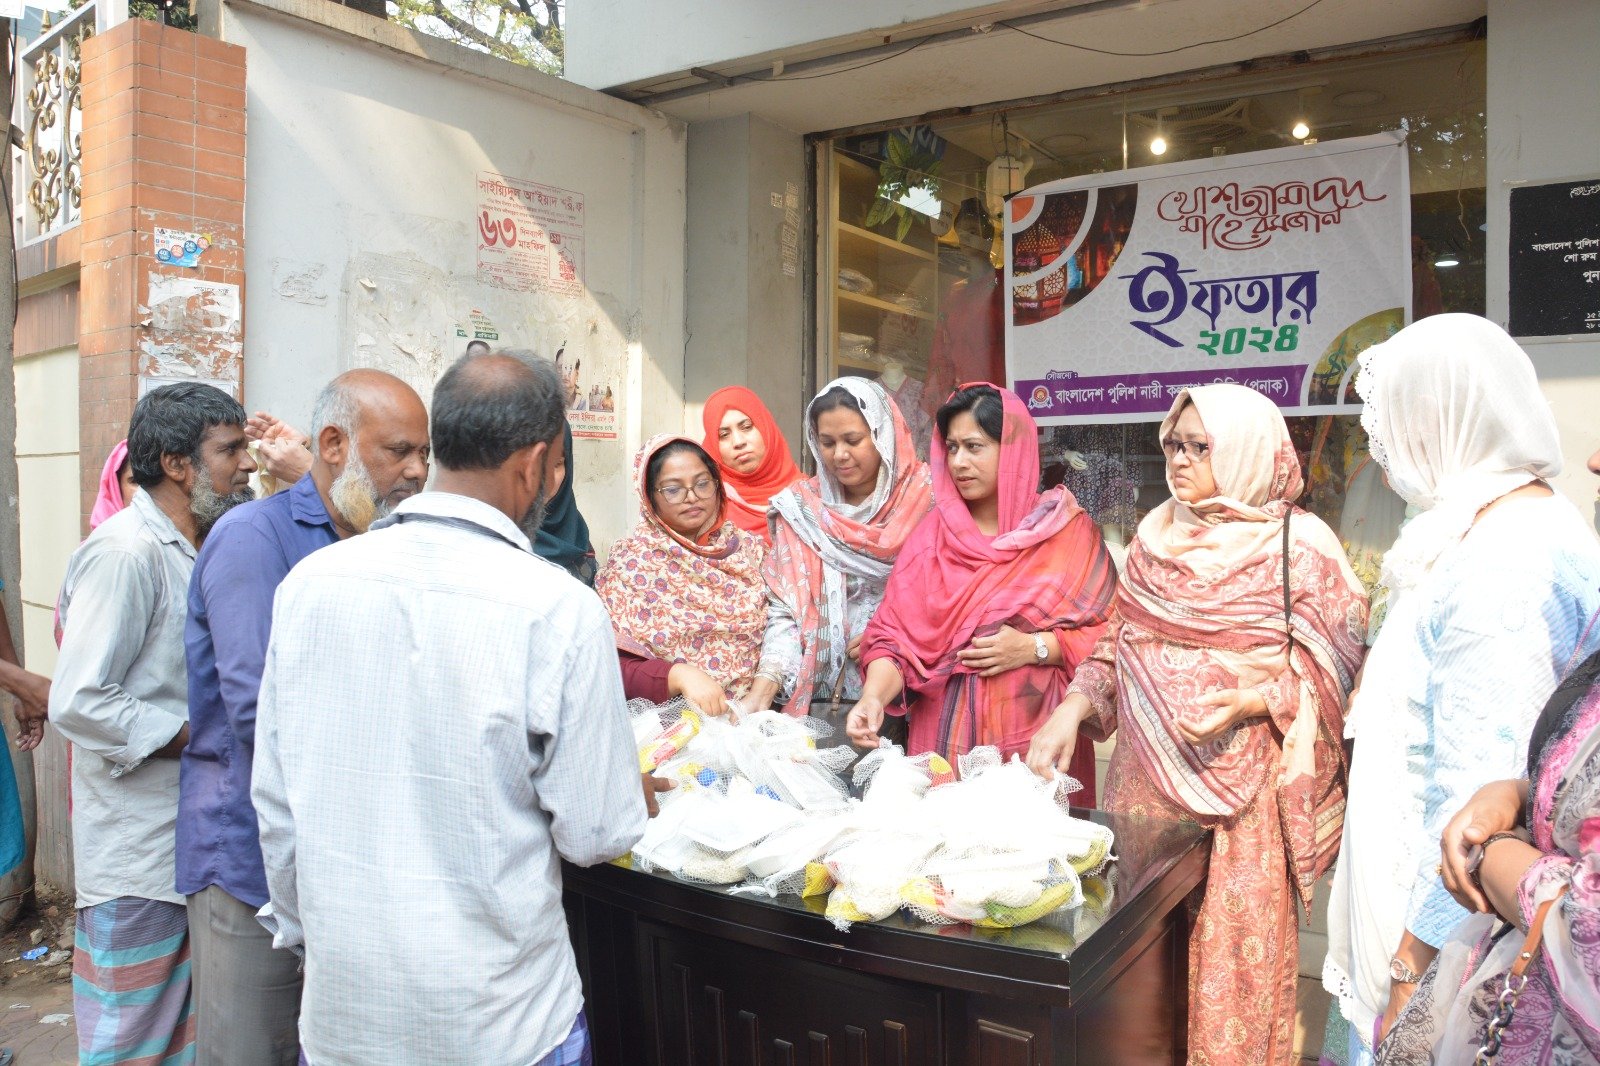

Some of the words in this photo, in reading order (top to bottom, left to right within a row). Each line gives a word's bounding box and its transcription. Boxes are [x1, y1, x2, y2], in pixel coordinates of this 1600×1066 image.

[479, 210, 517, 248] ৬৩
[1532, 241, 1572, 252] বাংলাদেশ
[1575, 238, 1600, 250] পুলিশ
[1564, 253, 1578, 263] শো
[1580, 252, 1597, 262] রুম
[1117, 251, 1320, 348] ইফতার
[1197, 324, 1300, 356] ২০২৪
[1055, 388, 1105, 405] বাংলাদেশ
[1108, 382, 1138, 404] পুলিশ
[1140, 380, 1163, 400] নারী
